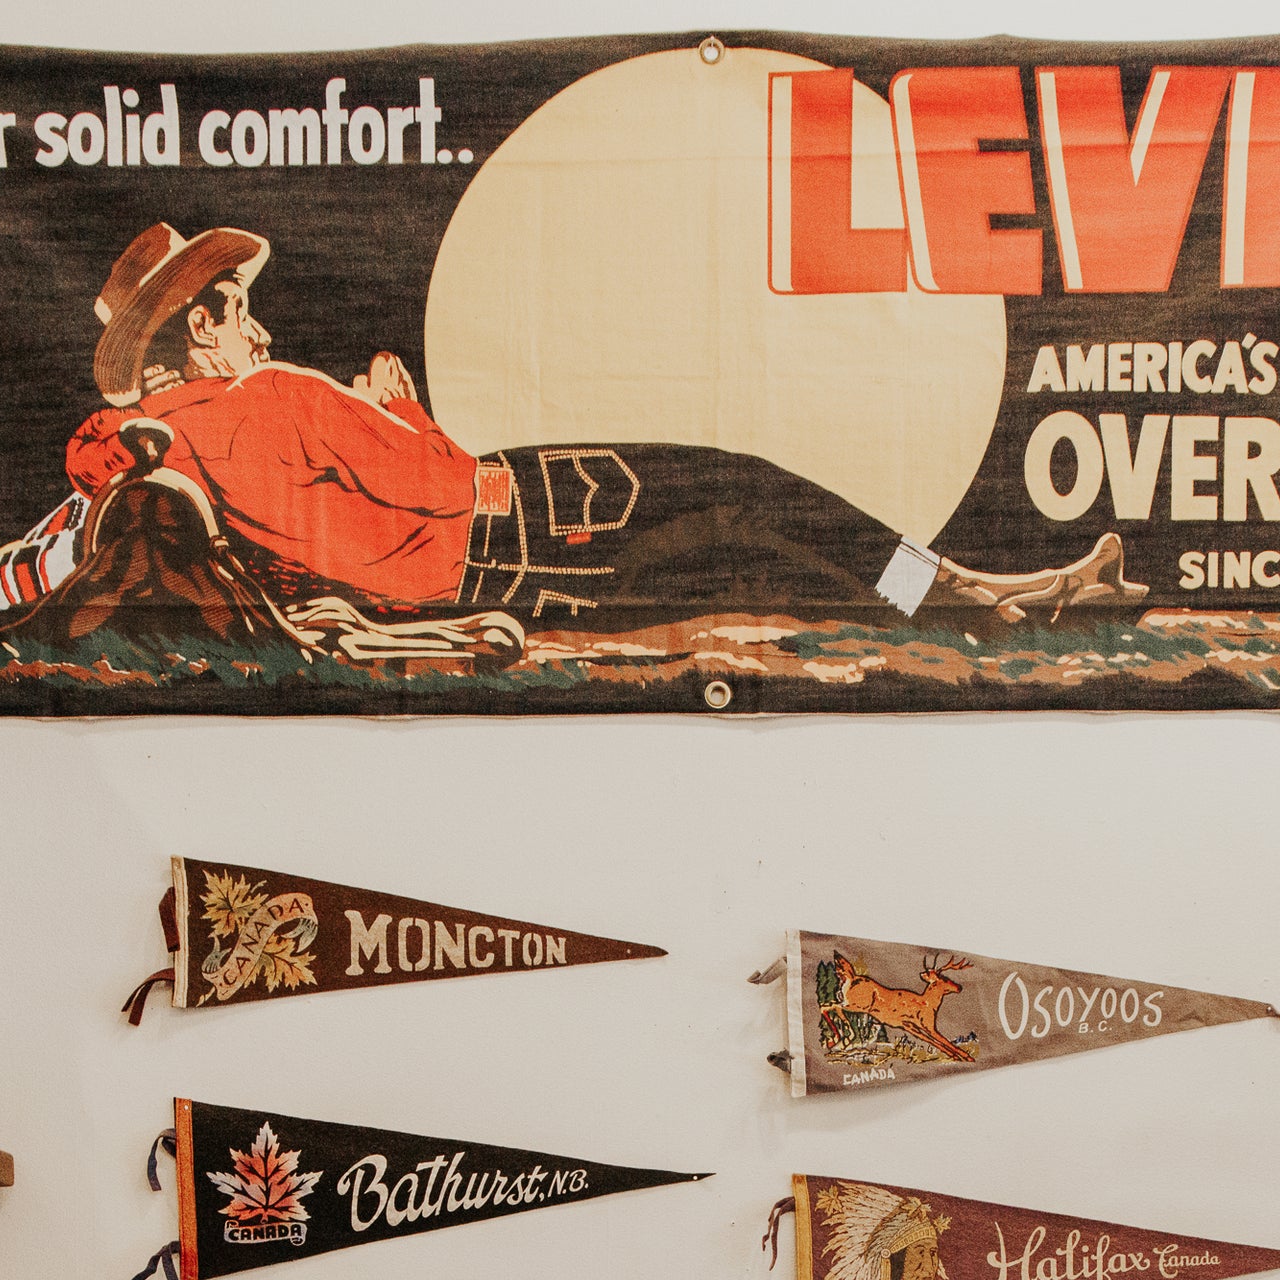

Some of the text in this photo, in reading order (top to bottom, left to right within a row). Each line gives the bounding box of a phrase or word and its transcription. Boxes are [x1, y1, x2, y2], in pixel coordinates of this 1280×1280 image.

[33, 82, 181, 168] solid
[1026, 332, 1280, 395] AMERICA'S
[343, 909, 569, 977] MONCTON
[842, 1067, 896, 1086] CANADA
[547, 1168, 590, 1200] N.B.
[226, 1223, 303, 1243] CANADA
[1155, 1243, 1222, 1280] Canada
